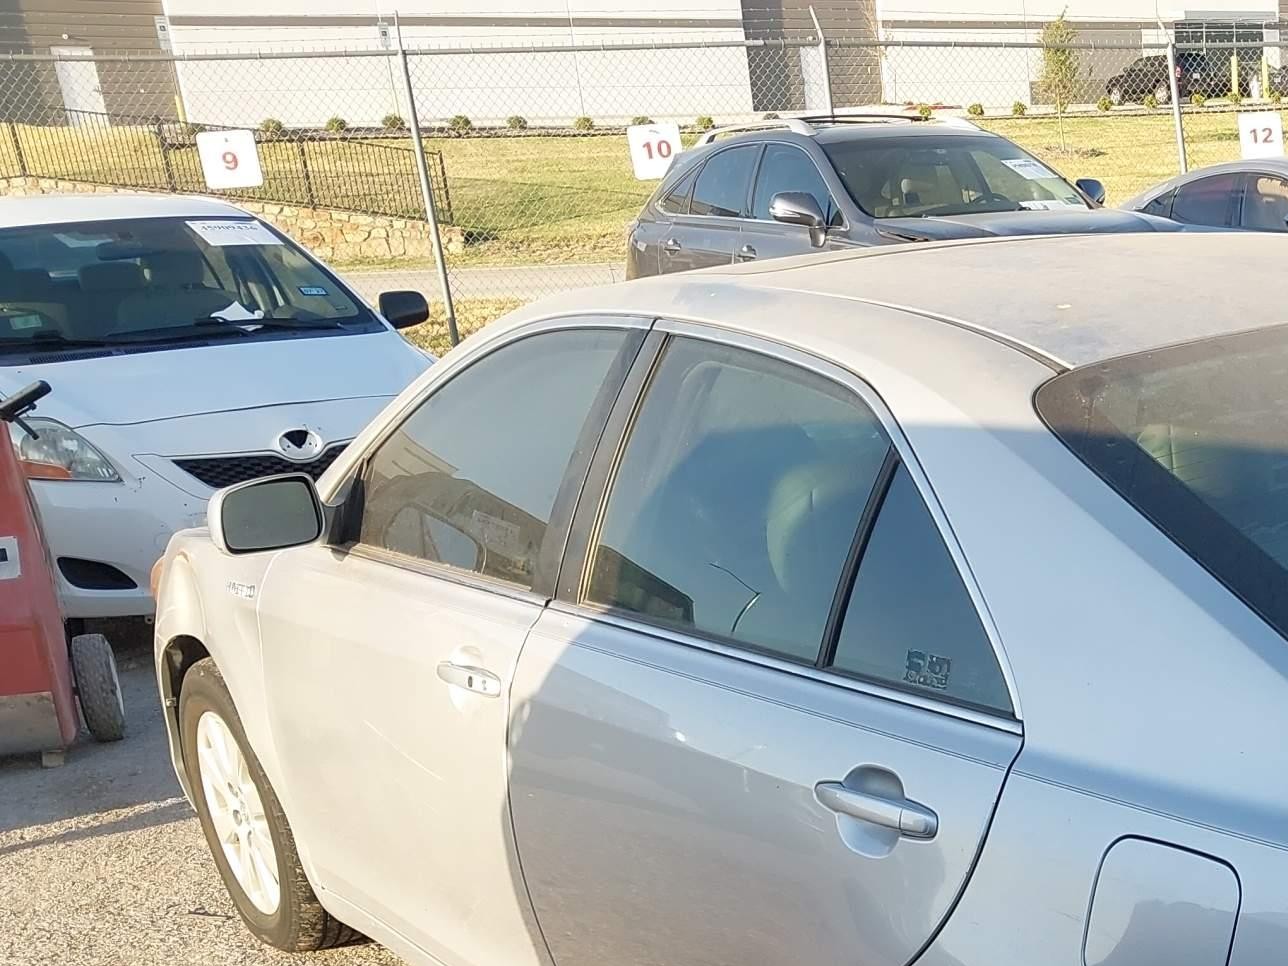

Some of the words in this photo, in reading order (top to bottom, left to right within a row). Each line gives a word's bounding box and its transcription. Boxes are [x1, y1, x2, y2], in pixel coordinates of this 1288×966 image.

[1249, 127, 1274, 144] 12
[642, 139, 672, 160] 10
[222, 151, 239, 171] 9
